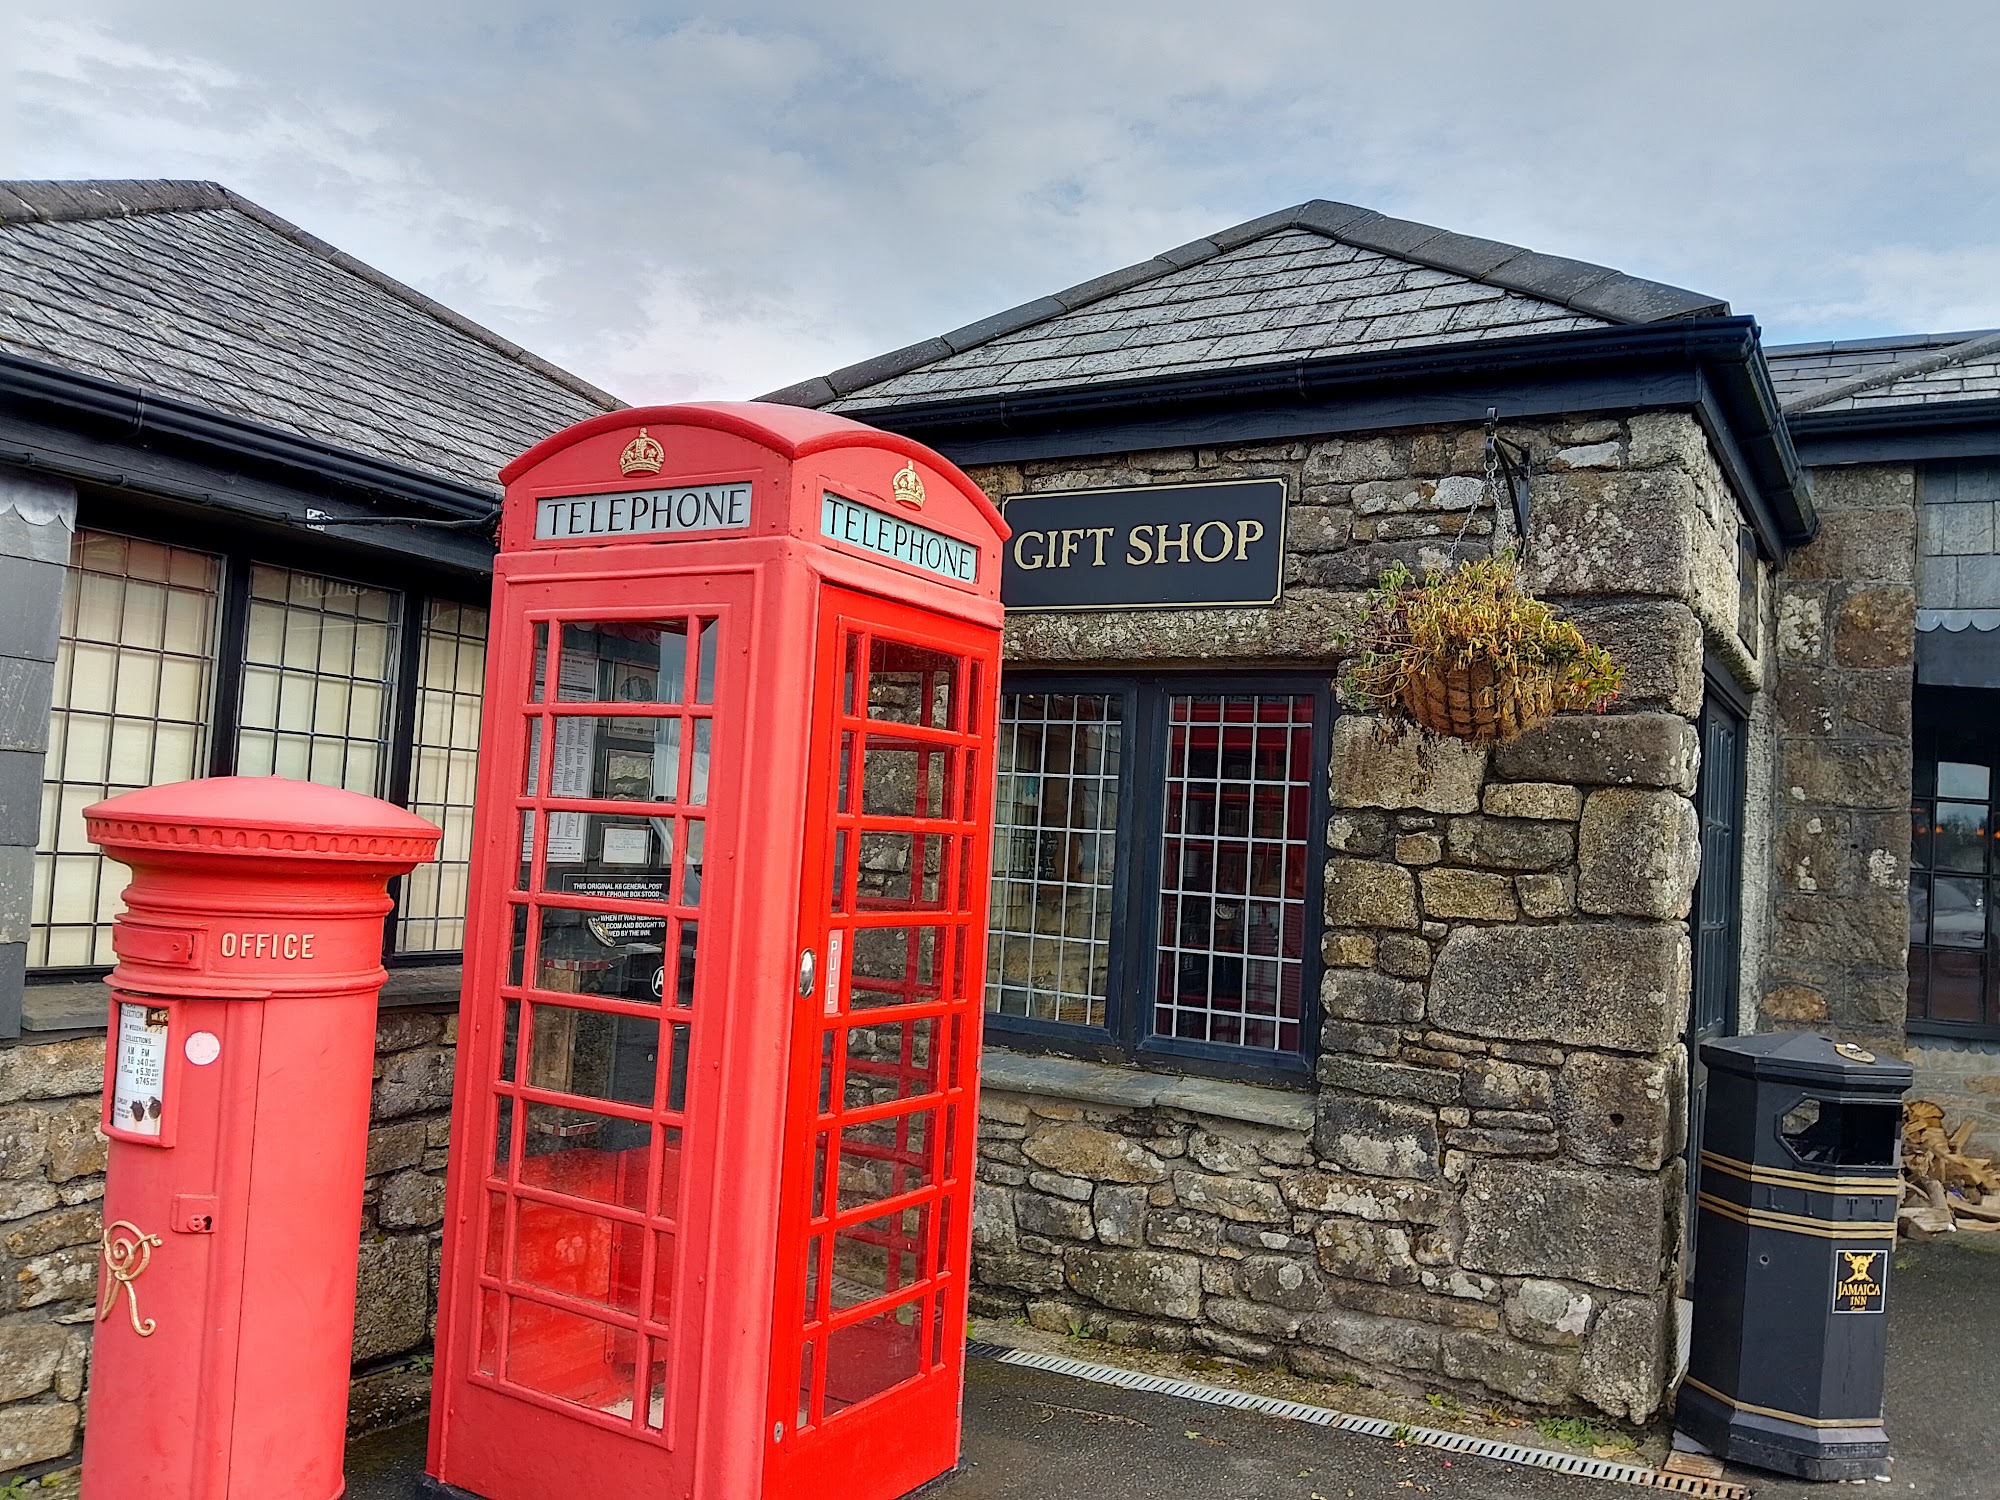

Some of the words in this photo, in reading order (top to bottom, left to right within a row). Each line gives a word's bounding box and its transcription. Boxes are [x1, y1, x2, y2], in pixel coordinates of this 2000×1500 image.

[547, 489, 747, 536] TELEPHONE
[826, 498, 972, 581] TELEPHONE
[1013, 527, 1115, 570] GIFT
[1126, 520, 1264, 565] SHOP
[221, 932, 315, 960] OFFICE
[827, 940, 838, 1004] PULL
[1836, 1281, 1881, 1300] JAMAICA
[1850, 1296, 1868, 1306] INN
